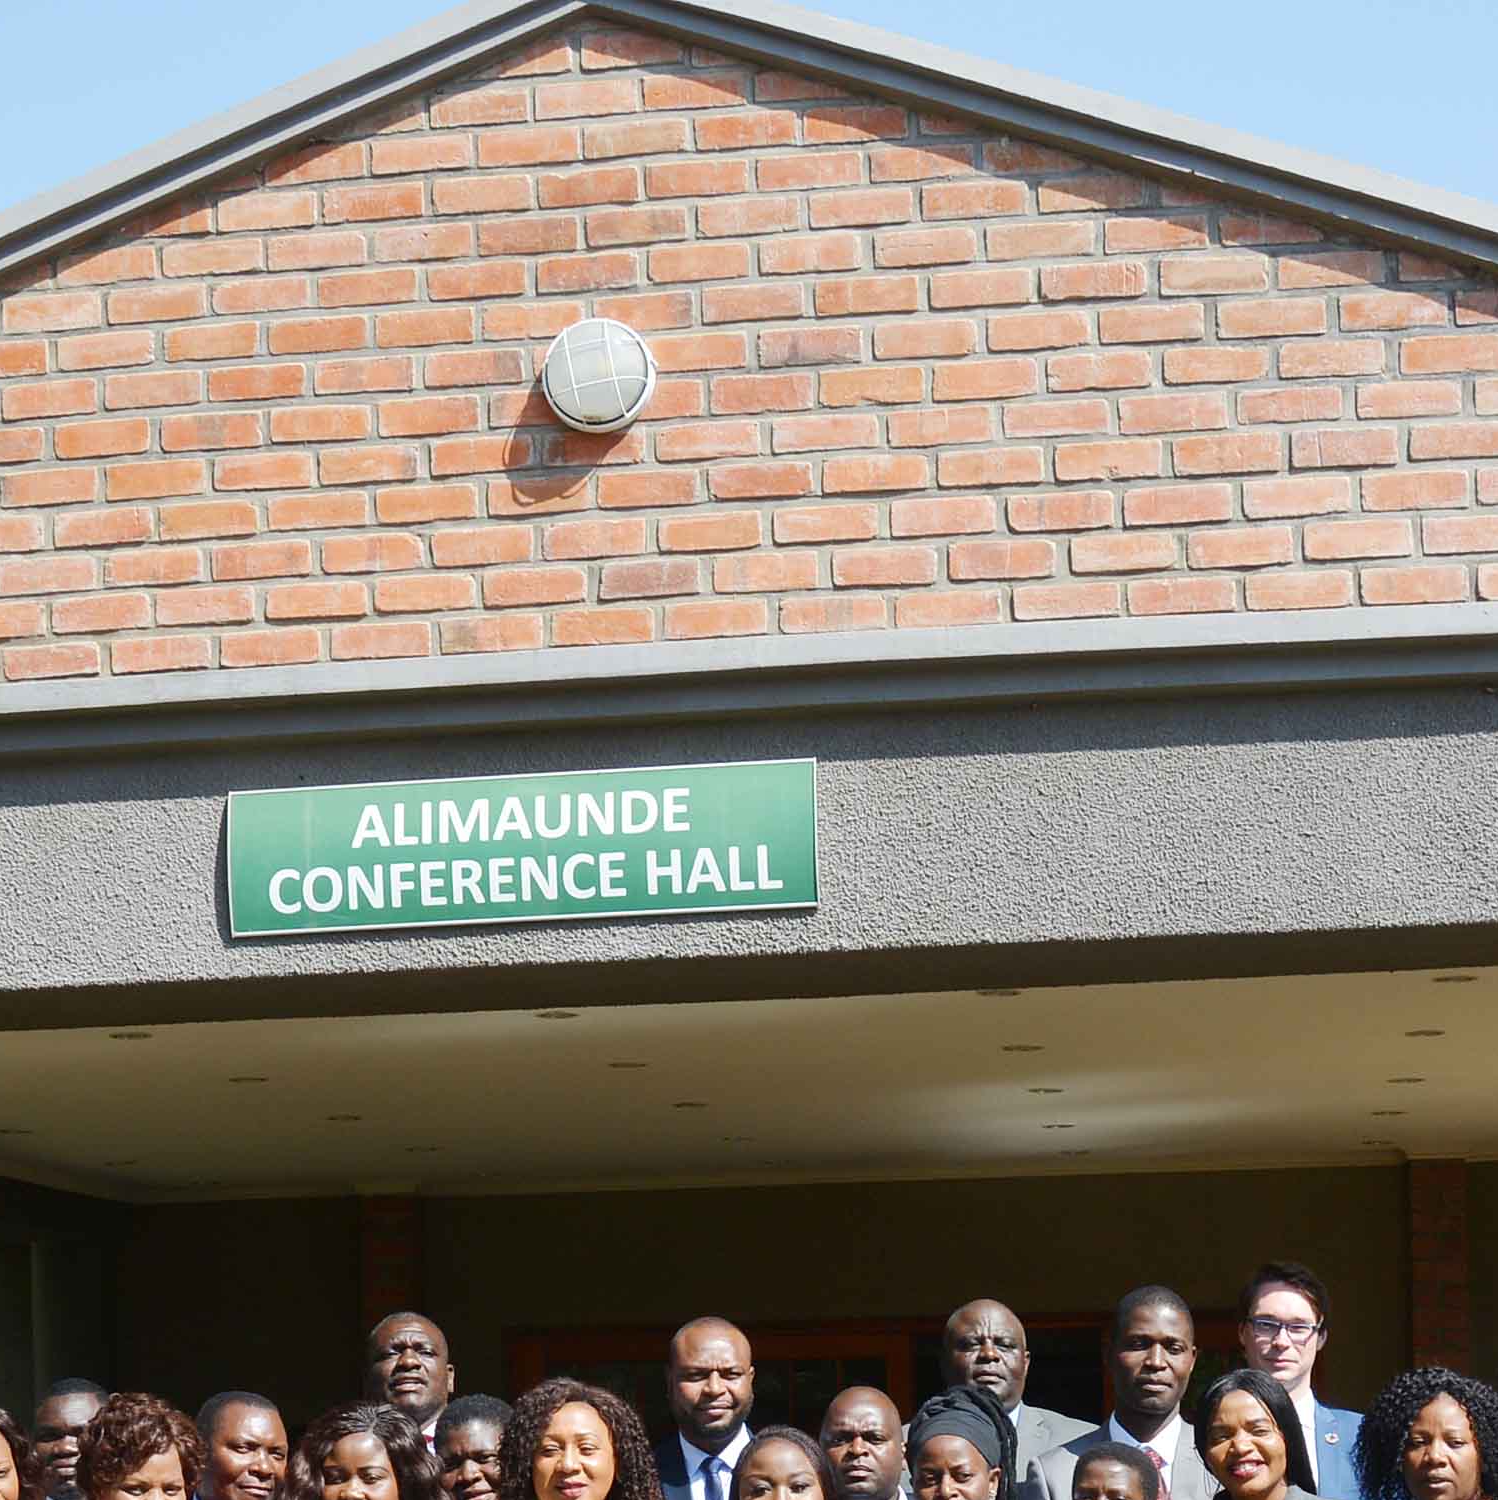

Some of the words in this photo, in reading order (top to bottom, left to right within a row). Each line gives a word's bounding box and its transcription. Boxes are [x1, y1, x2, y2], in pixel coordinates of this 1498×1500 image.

[351, 787, 690, 849] ALIMAUNDE
[269, 852, 627, 914] CONFERENCE
[646, 845, 783, 895] HALL
